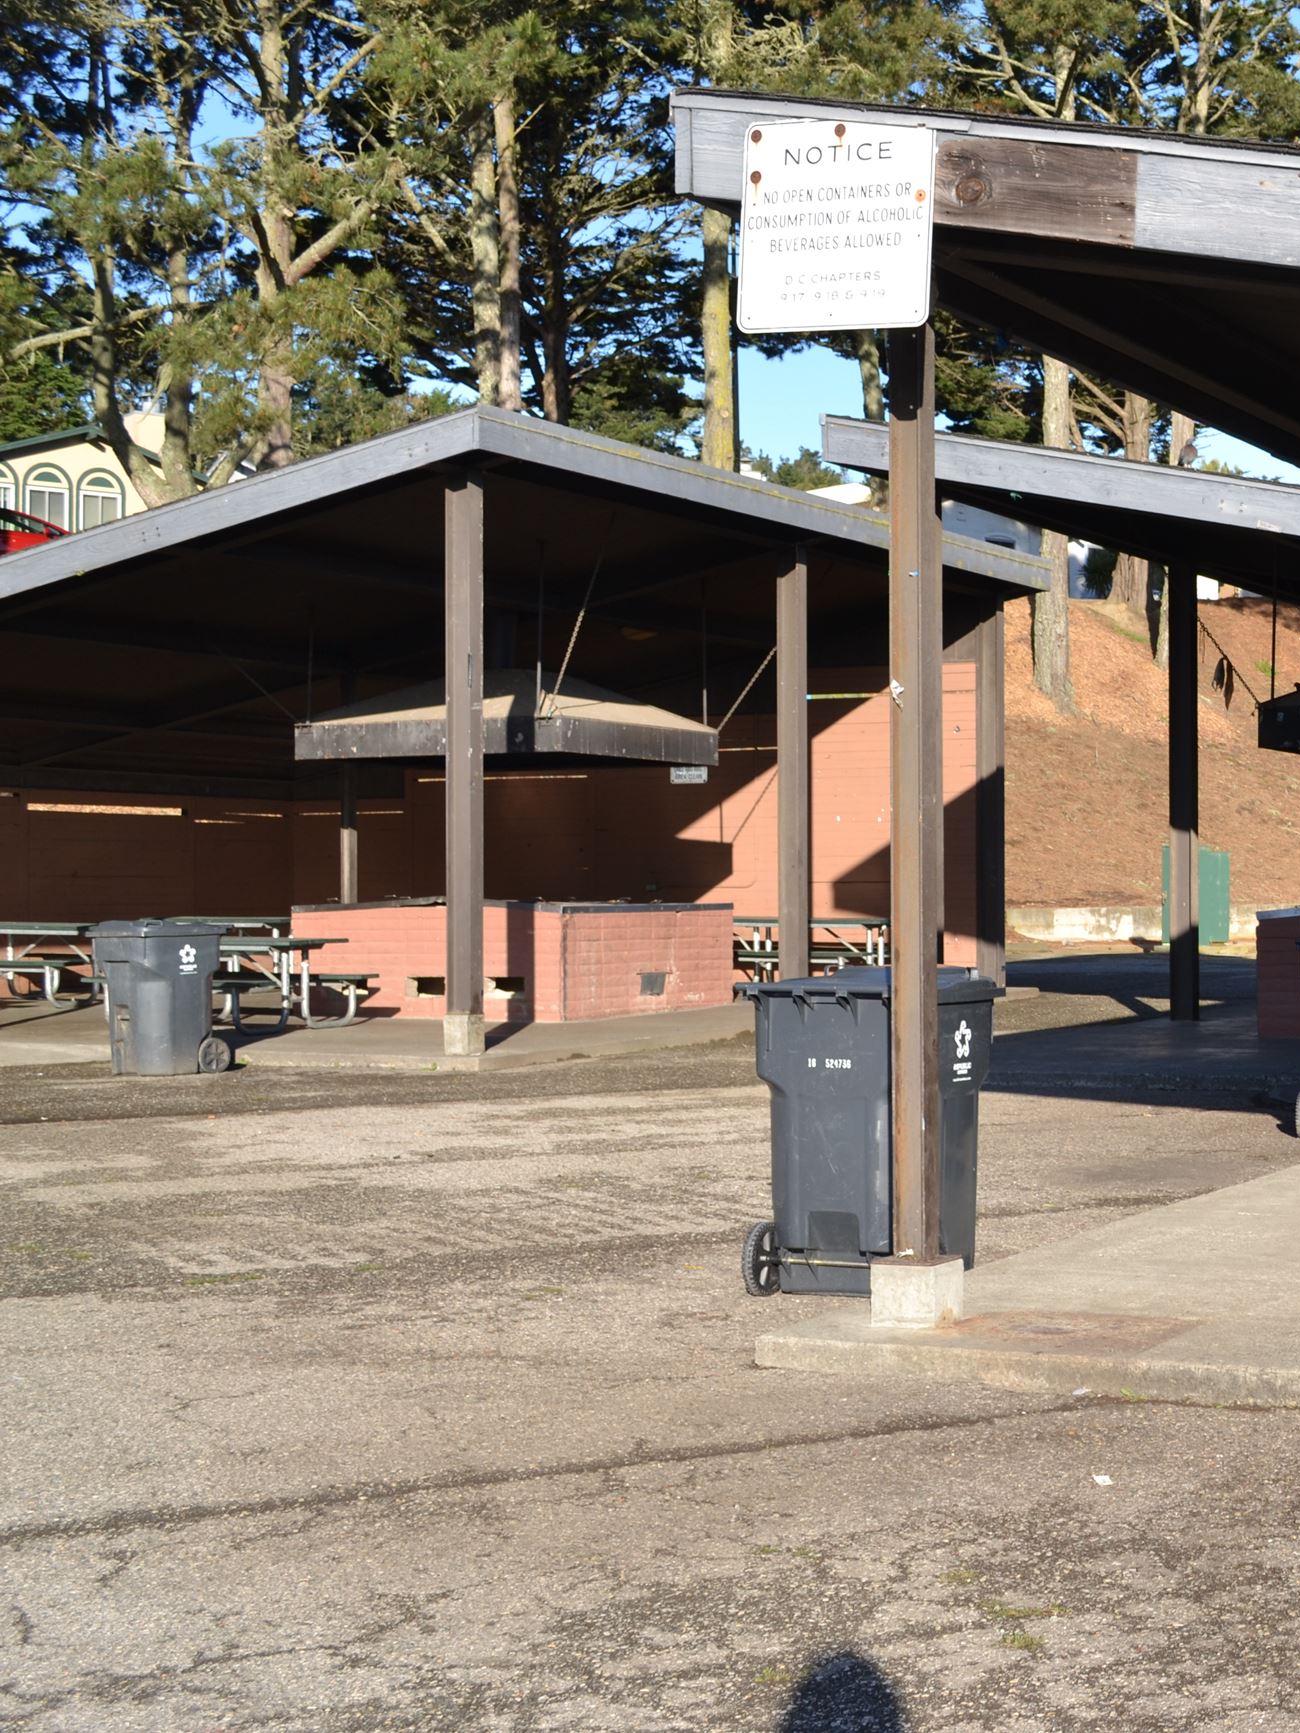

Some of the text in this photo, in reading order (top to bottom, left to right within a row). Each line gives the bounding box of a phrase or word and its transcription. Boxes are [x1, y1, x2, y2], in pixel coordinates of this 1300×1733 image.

[784, 141, 892, 166] NOTICE
[763, 182, 912, 205] NO OPEN CONTAINERS OR
[748, 206, 924, 230] CONSUMPTION OF ALCOHOLIC
[770, 232, 902, 253] BEVERAGES ALLOWED
